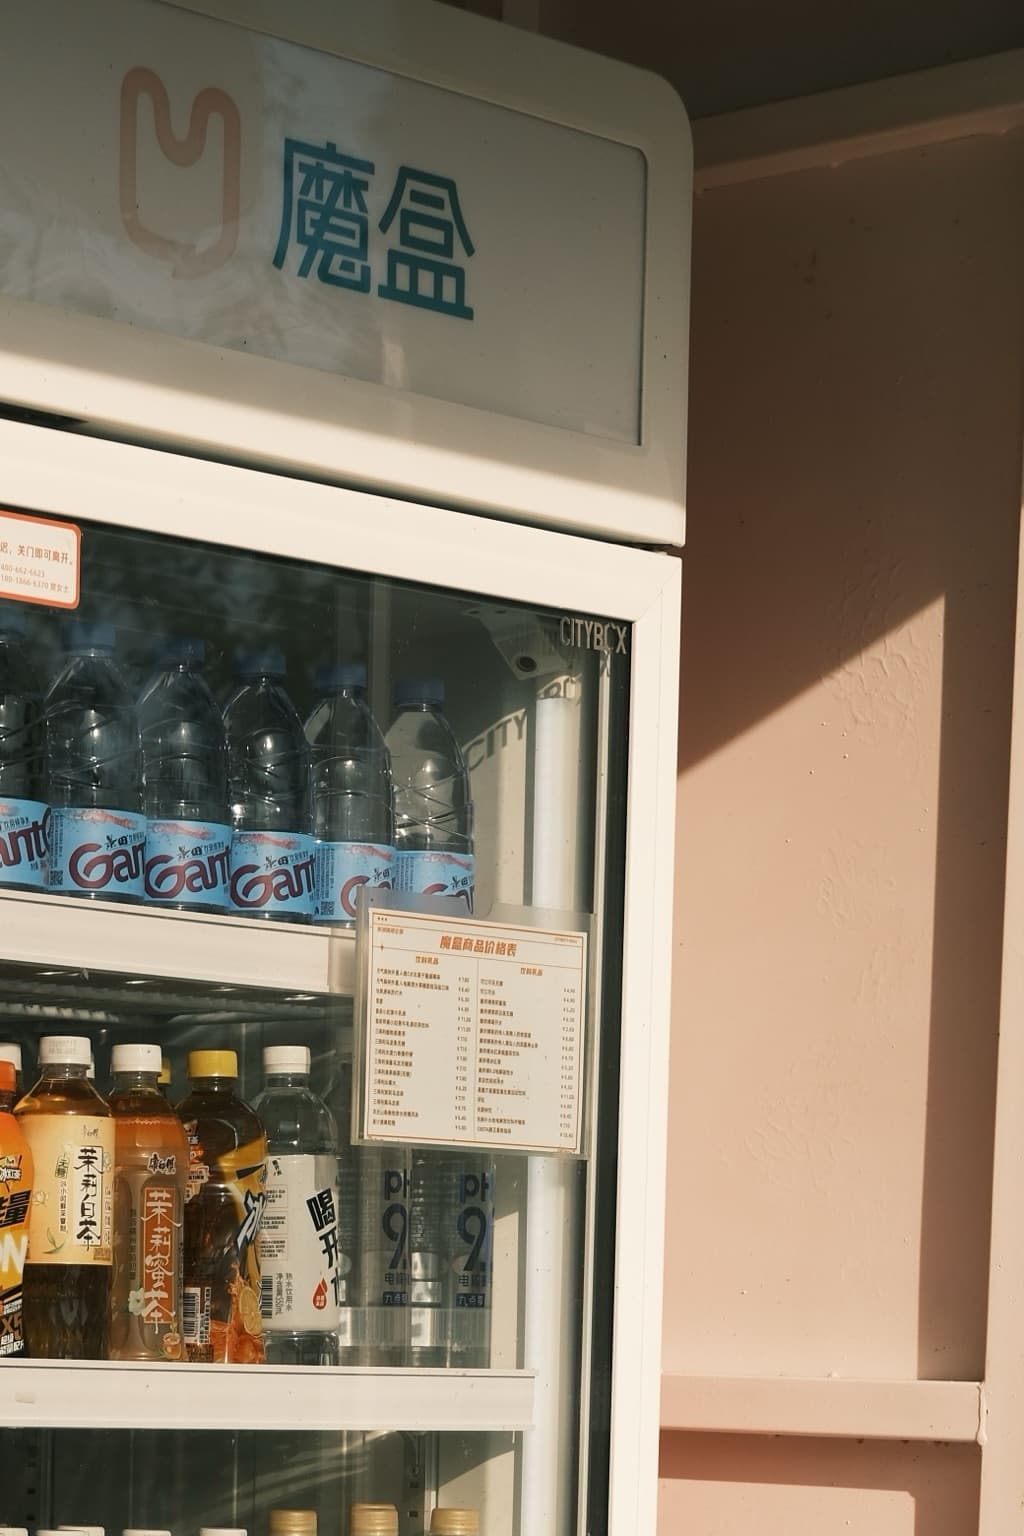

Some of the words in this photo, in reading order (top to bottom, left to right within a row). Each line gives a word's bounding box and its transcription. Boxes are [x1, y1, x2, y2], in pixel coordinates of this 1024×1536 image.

[272, 136, 475, 321] 魔盒
[440, 935, 517, 957] 魔盒商品价格表
[73, 1147, 104, 1252] 茉莉白茶
[141, 1188, 182, 1335] 茉莉蜜茶
